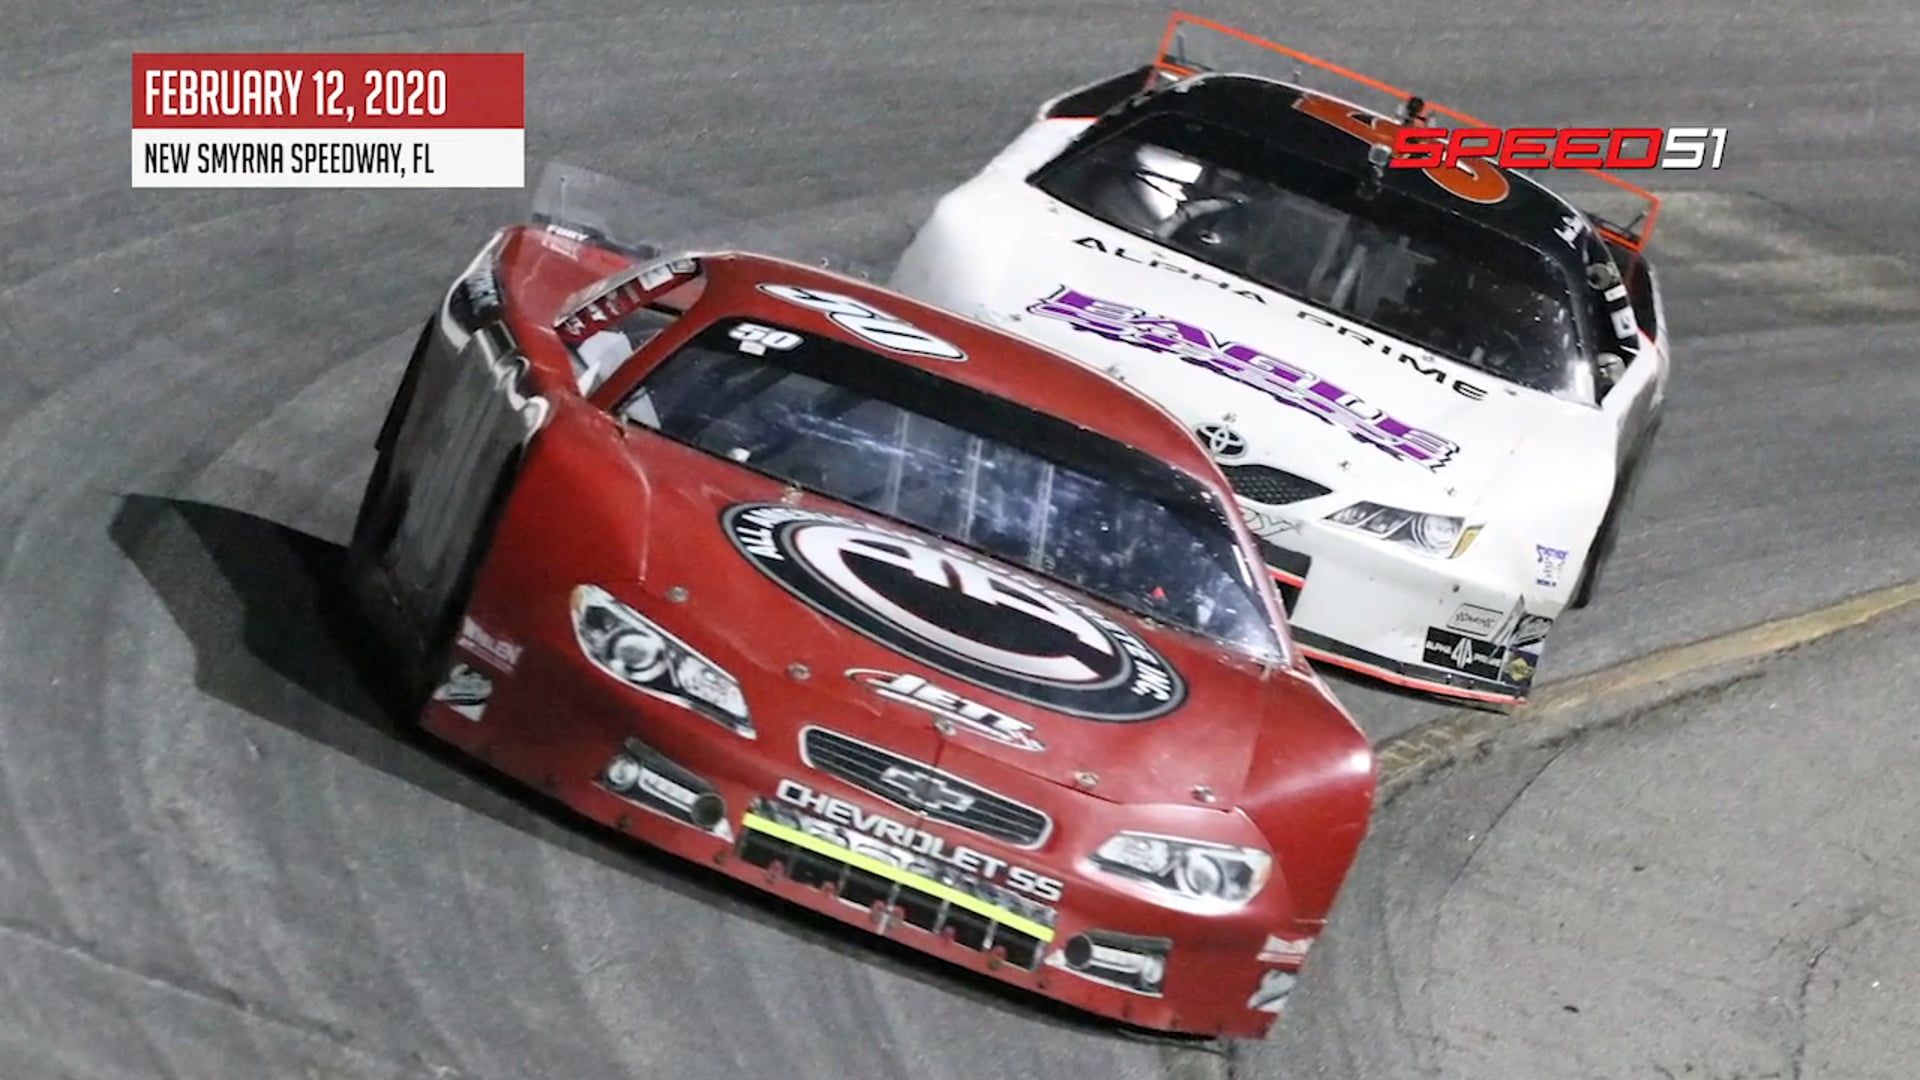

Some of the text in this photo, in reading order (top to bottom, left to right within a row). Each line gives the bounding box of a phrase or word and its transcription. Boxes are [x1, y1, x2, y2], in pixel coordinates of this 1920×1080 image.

[728, 322, 804, 351] 50
[1026, 284, 1461, 474] EAGLE
[1073, 235, 1489, 401] ALPHA PRIME
[736, 526, 785, 561] ALL
[1131, 659, 1173, 701] INC.
[776, 778, 1007, 878] CHEVROLET
[1006, 865, 1065, 902] SS
